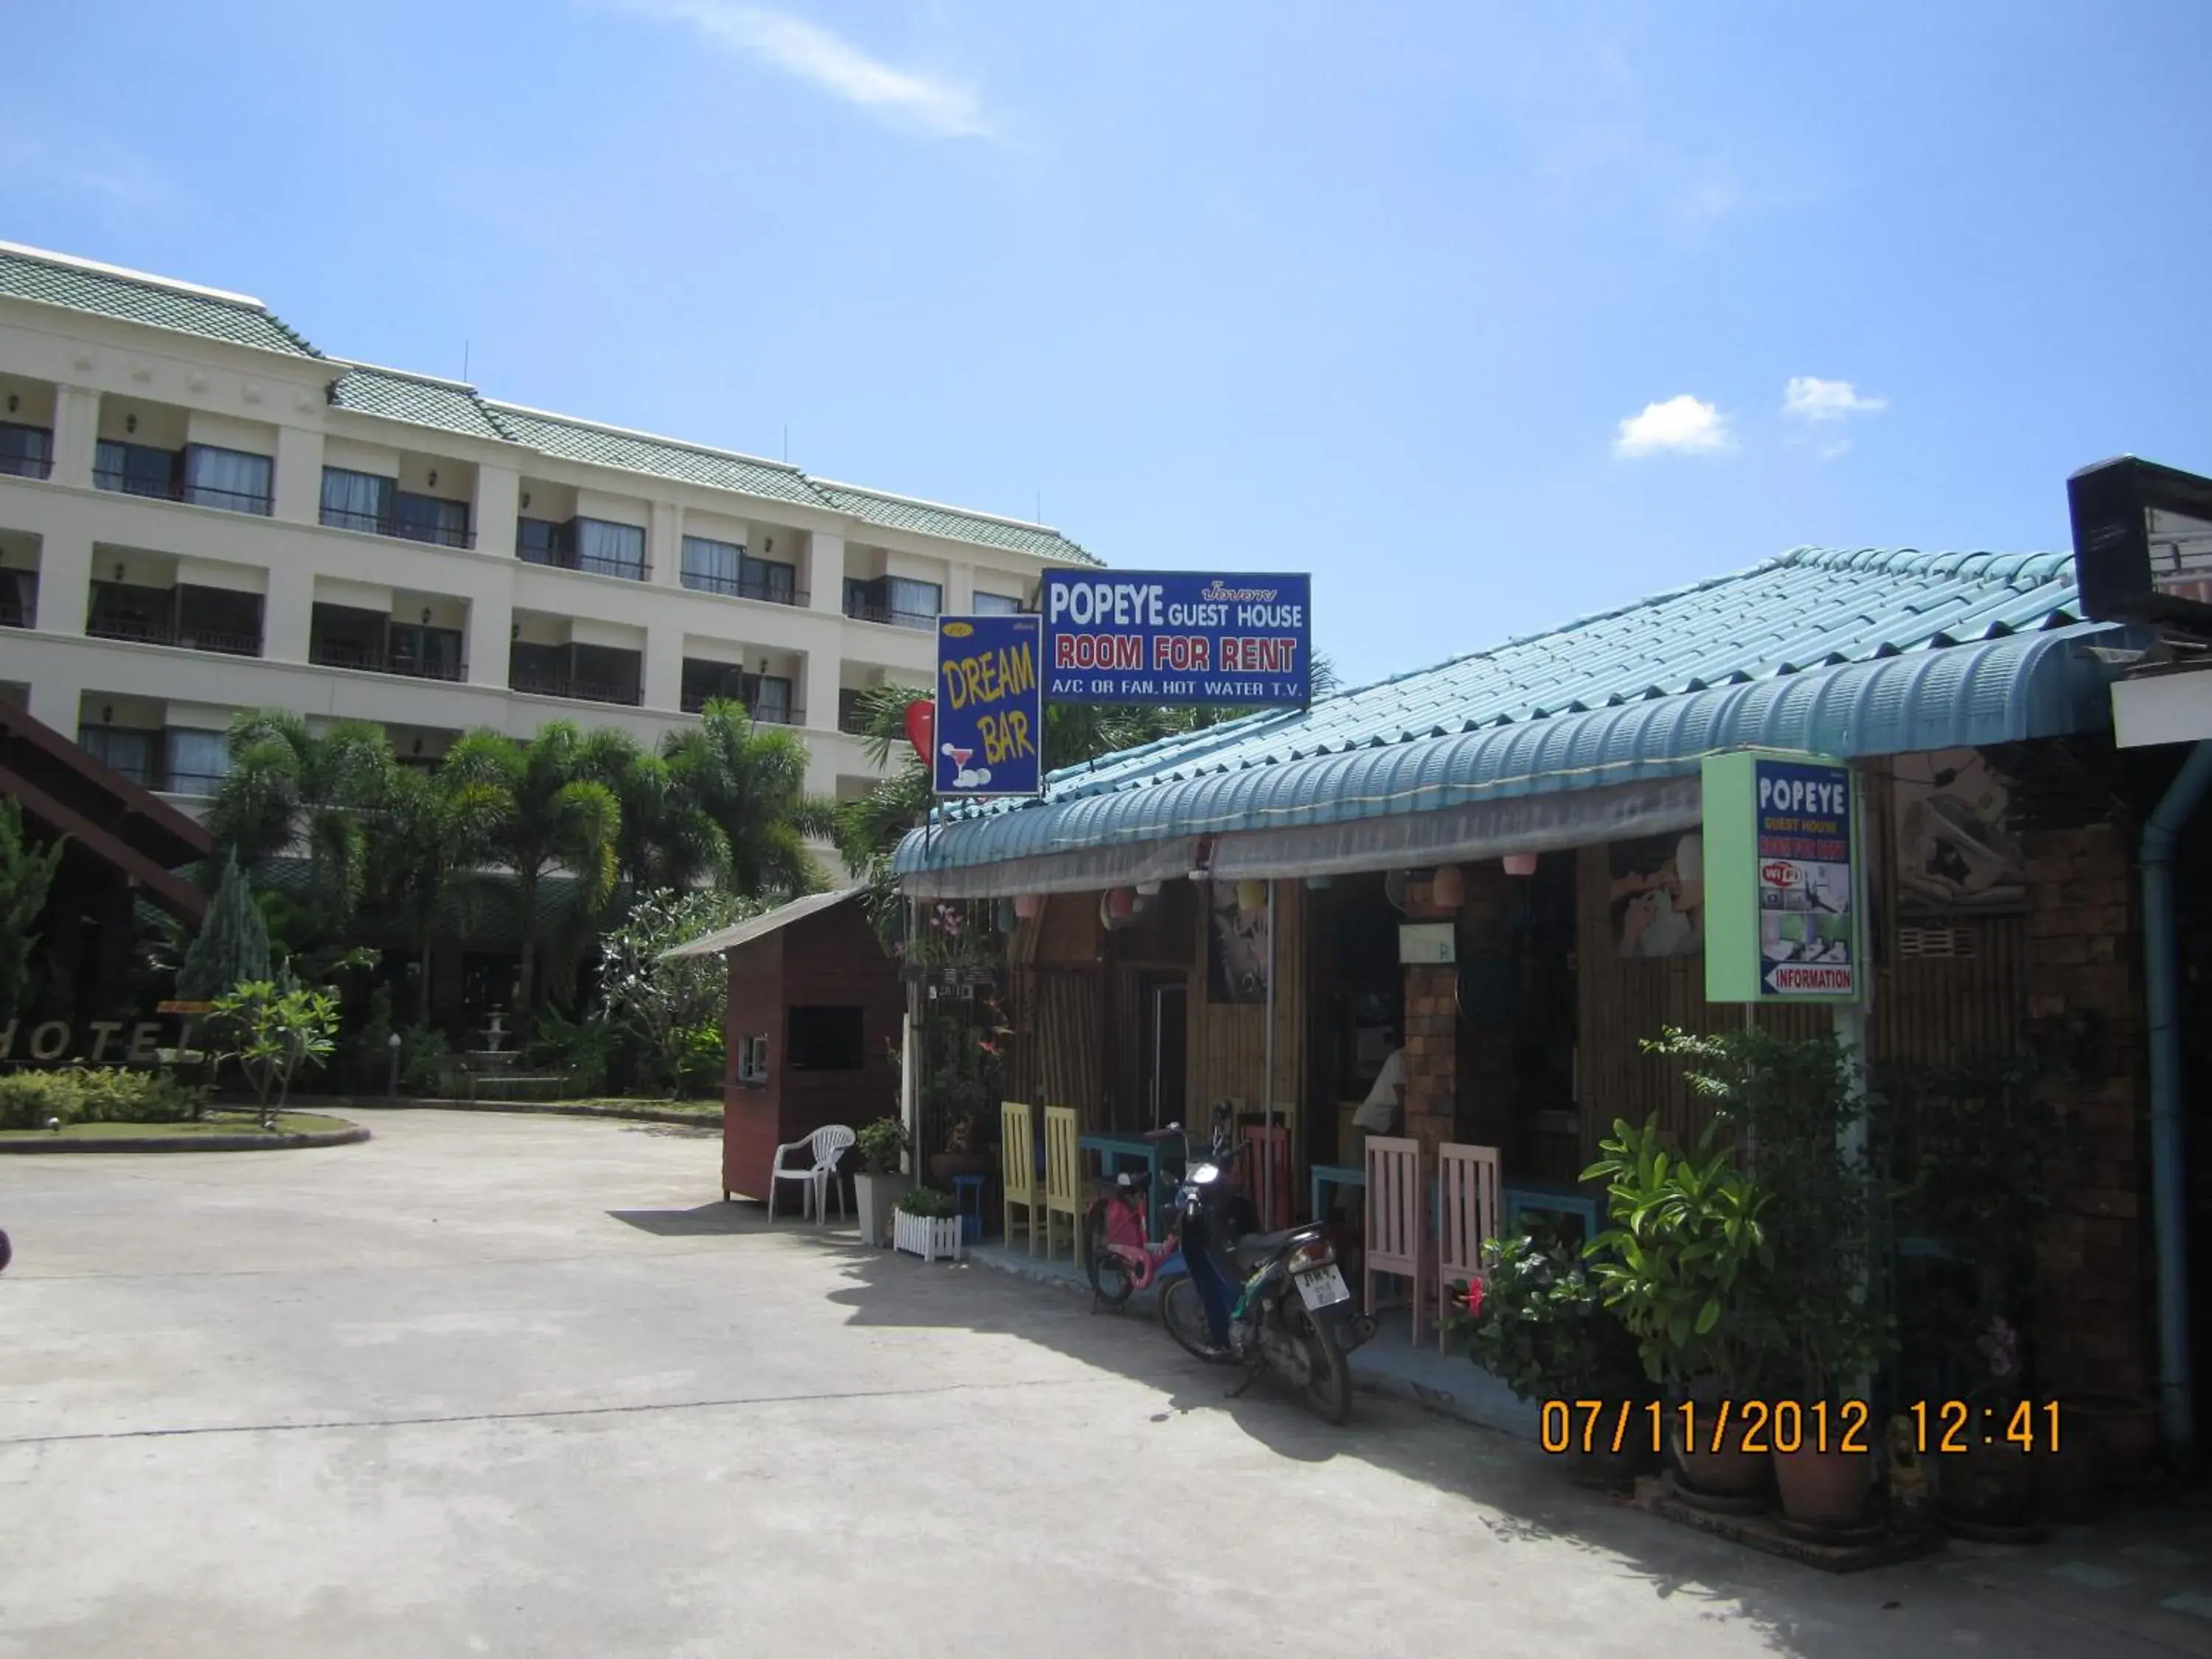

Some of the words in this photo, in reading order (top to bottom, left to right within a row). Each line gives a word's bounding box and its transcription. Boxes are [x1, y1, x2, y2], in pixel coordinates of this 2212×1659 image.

[1050, 582, 1164, 626] POPEYE
[1168, 603, 1229, 626] GUEST
[1238, 605, 1302, 627] HOUSE
[1055, 633, 1143, 669] ROOM
[1152, 635, 1210, 672] FOR
[1220, 636, 1297, 672] RENT
[942, 641, 1036, 709] DREAM
[1052, 678, 1083, 693] A/C
[1091, 679, 1114, 694] OR
[1163, 680, 1195, 695] HOT
[1205, 681, 1263, 696] WATER
[1271, 681, 1303, 697] T.V.
[976, 709, 1036, 765] BAR
[1760, 777, 1845, 815] POPEYE
[1776, 968, 1851, 989] INFORMATION
